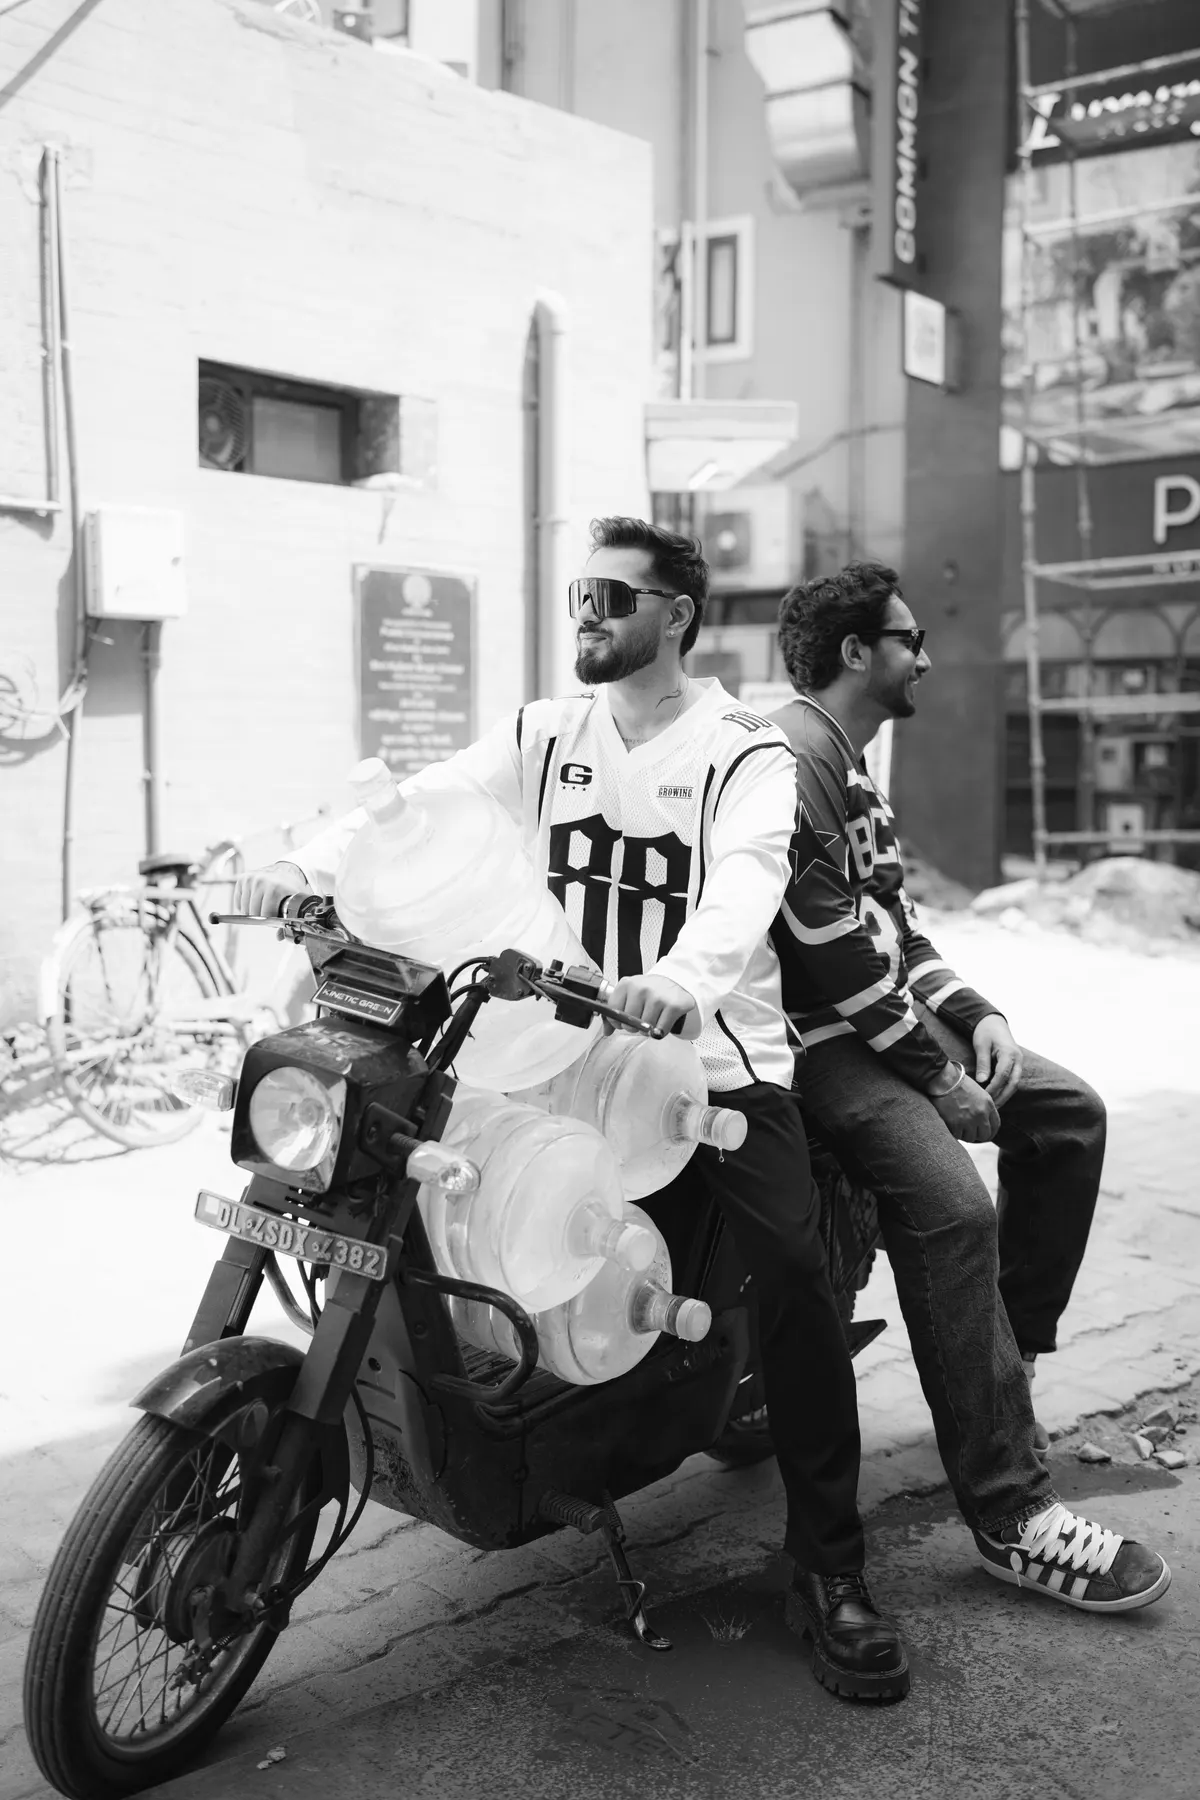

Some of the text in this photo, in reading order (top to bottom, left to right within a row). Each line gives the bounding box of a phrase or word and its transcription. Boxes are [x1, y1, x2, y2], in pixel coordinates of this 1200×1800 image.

[895, 46, 919, 264] COMMON
[560, 763, 593, 785] G
[658, 787, 694, 799] GROWING
[547, 813, 693, 984] 88
[322, 988, 360, 1005] KINETIC
[217, 1202, 241, 1233] DL
